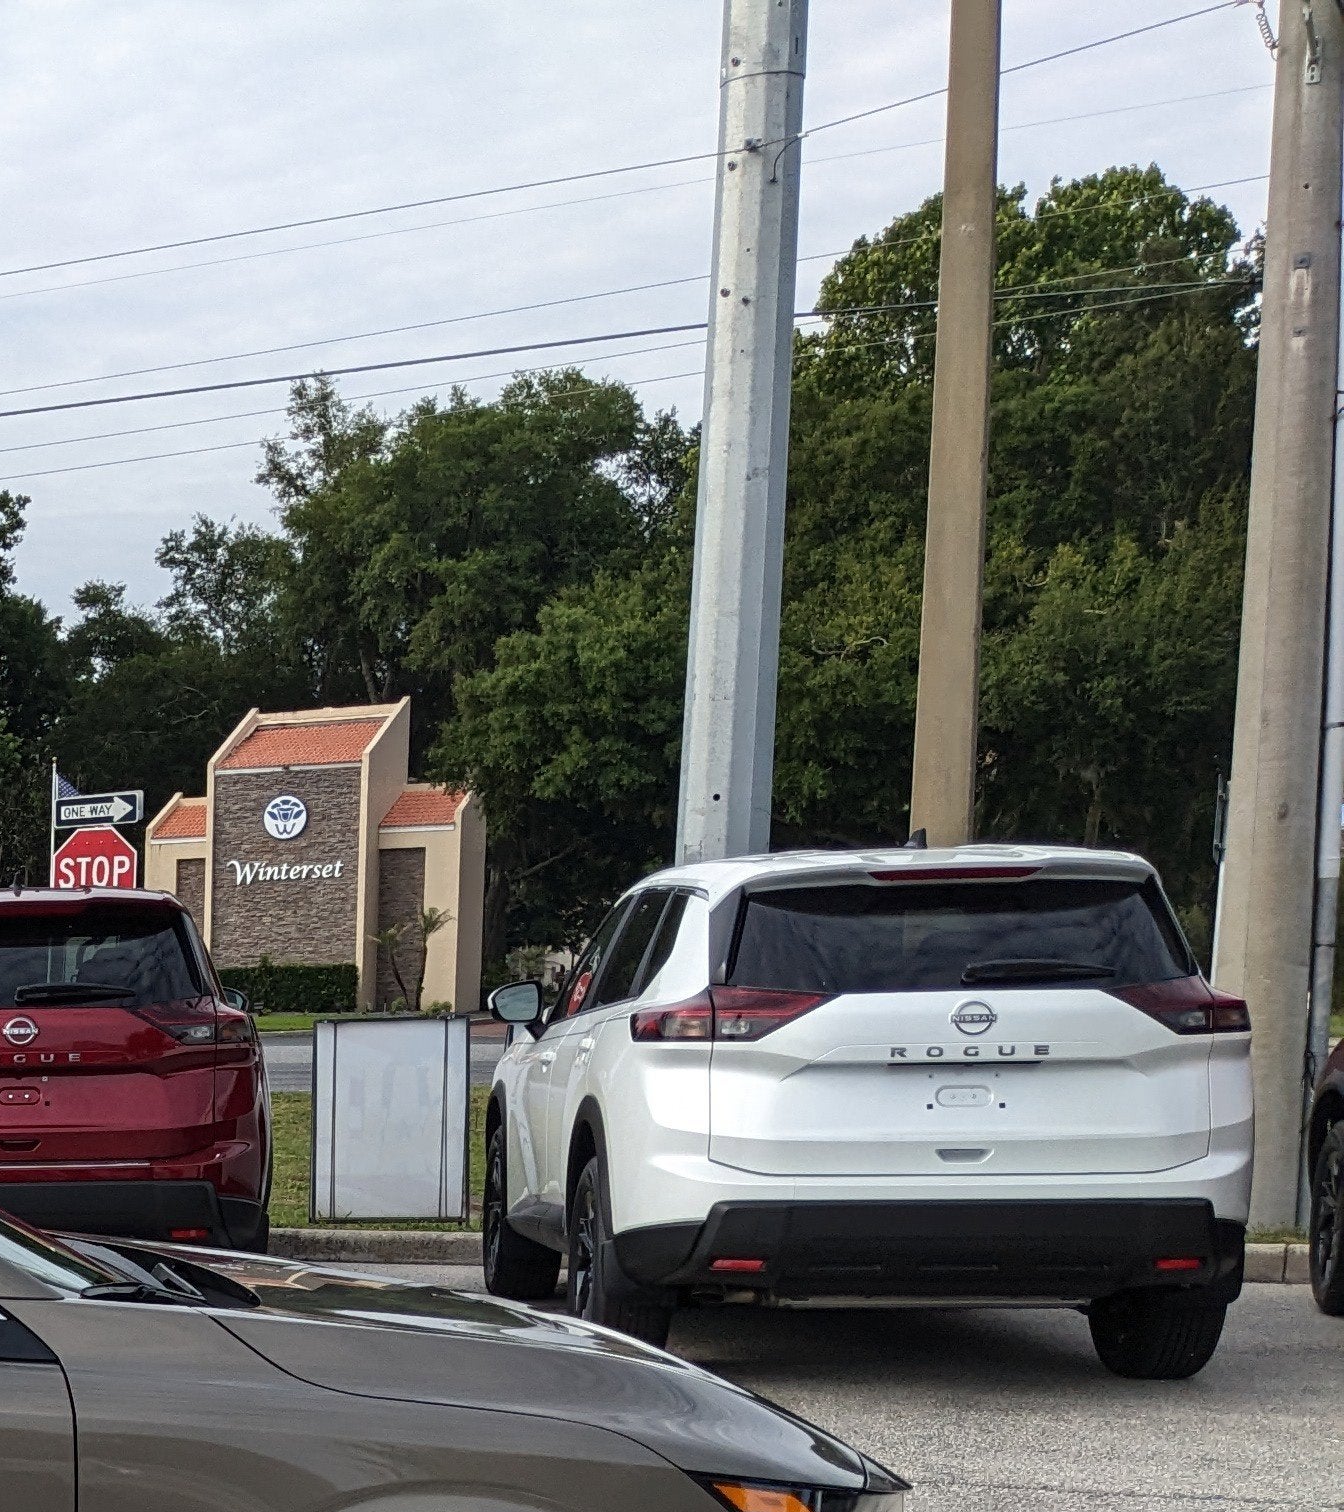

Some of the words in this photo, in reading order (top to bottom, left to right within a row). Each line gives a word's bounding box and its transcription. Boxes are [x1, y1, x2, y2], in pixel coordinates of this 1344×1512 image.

[63, 806, 86, 818] ONE
[89, 804, 113, 817] WAY
[58, 855, 131, 888] STOP
[226, 860, 345, 886] Winterset
[951, 1014, 997, 1023] NISSAN
[2, 1027, 39, 1035] NISSAN
[890, 1044, 1050, 1059] ROGUE
